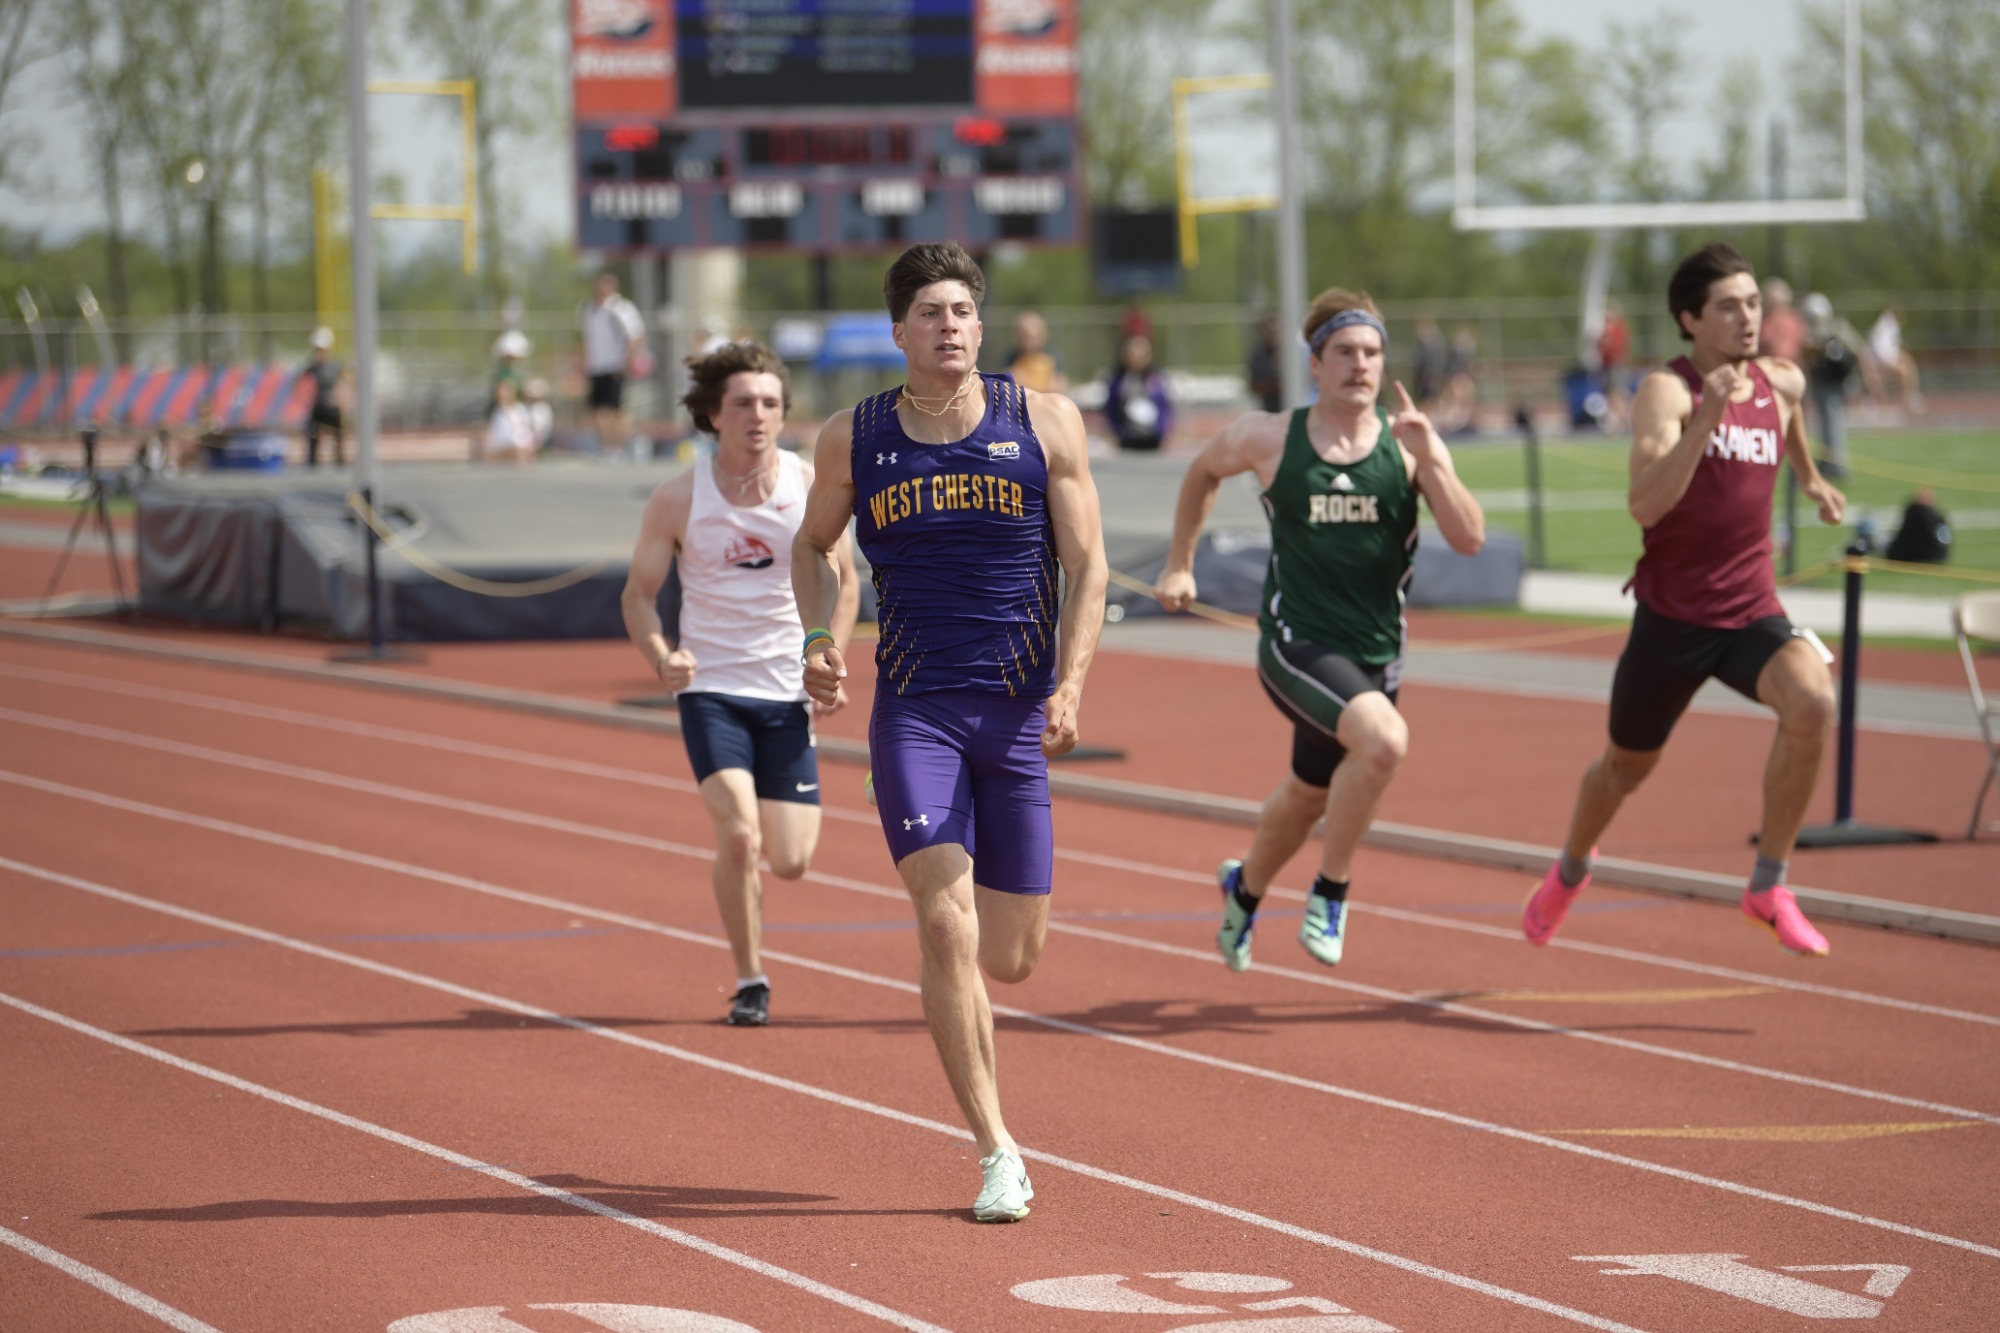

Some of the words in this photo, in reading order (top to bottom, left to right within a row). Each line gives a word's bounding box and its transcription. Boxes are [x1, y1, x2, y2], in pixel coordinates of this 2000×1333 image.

[989, 445, 1019, 455] PSAC
[870, 478, 923, 530] WEST
[932, 473, 1024, 518] CHESTER
[1309, 494, 1379, 523] ROCK
